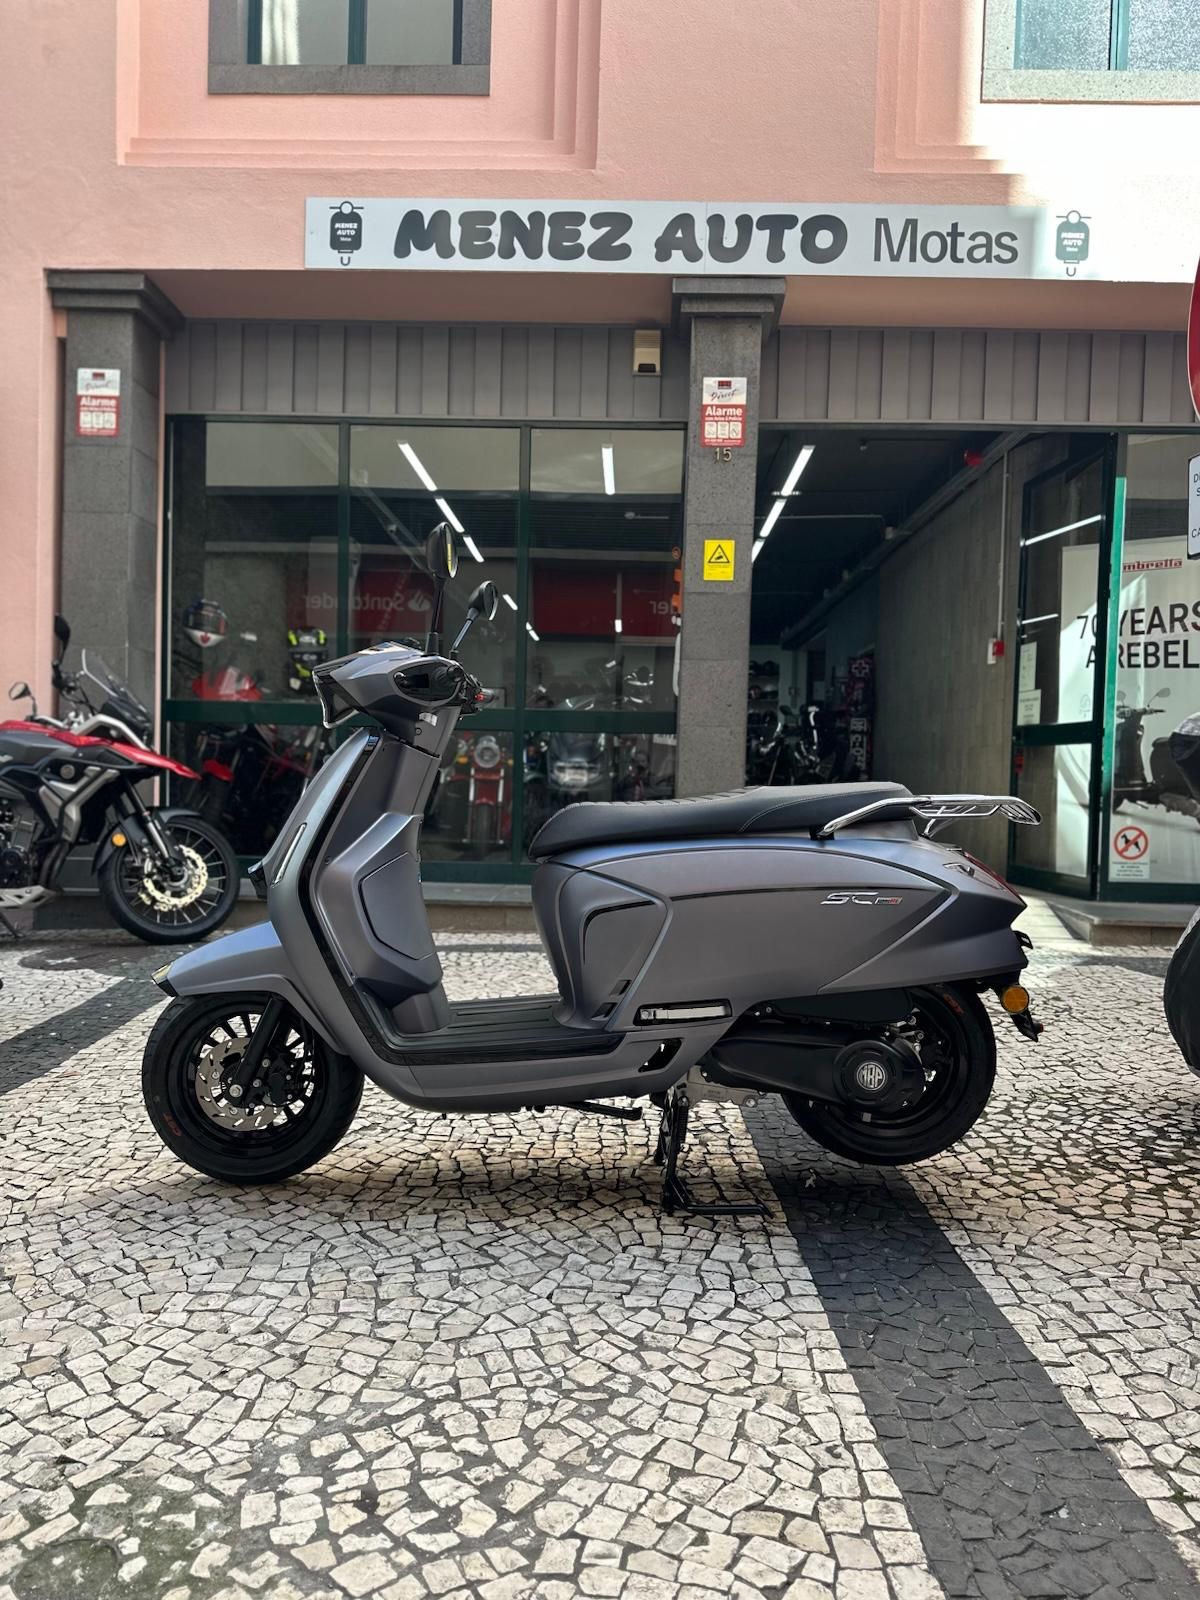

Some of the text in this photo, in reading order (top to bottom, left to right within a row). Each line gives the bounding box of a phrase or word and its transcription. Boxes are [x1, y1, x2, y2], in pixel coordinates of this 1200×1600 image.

[394, 209, 1019, 265] MENEZ AUTO Motas
[80, 396, 117, 407] Alarme
[705, 406, 743, 416] Alarme
[714, 447, 732, 462] 15
